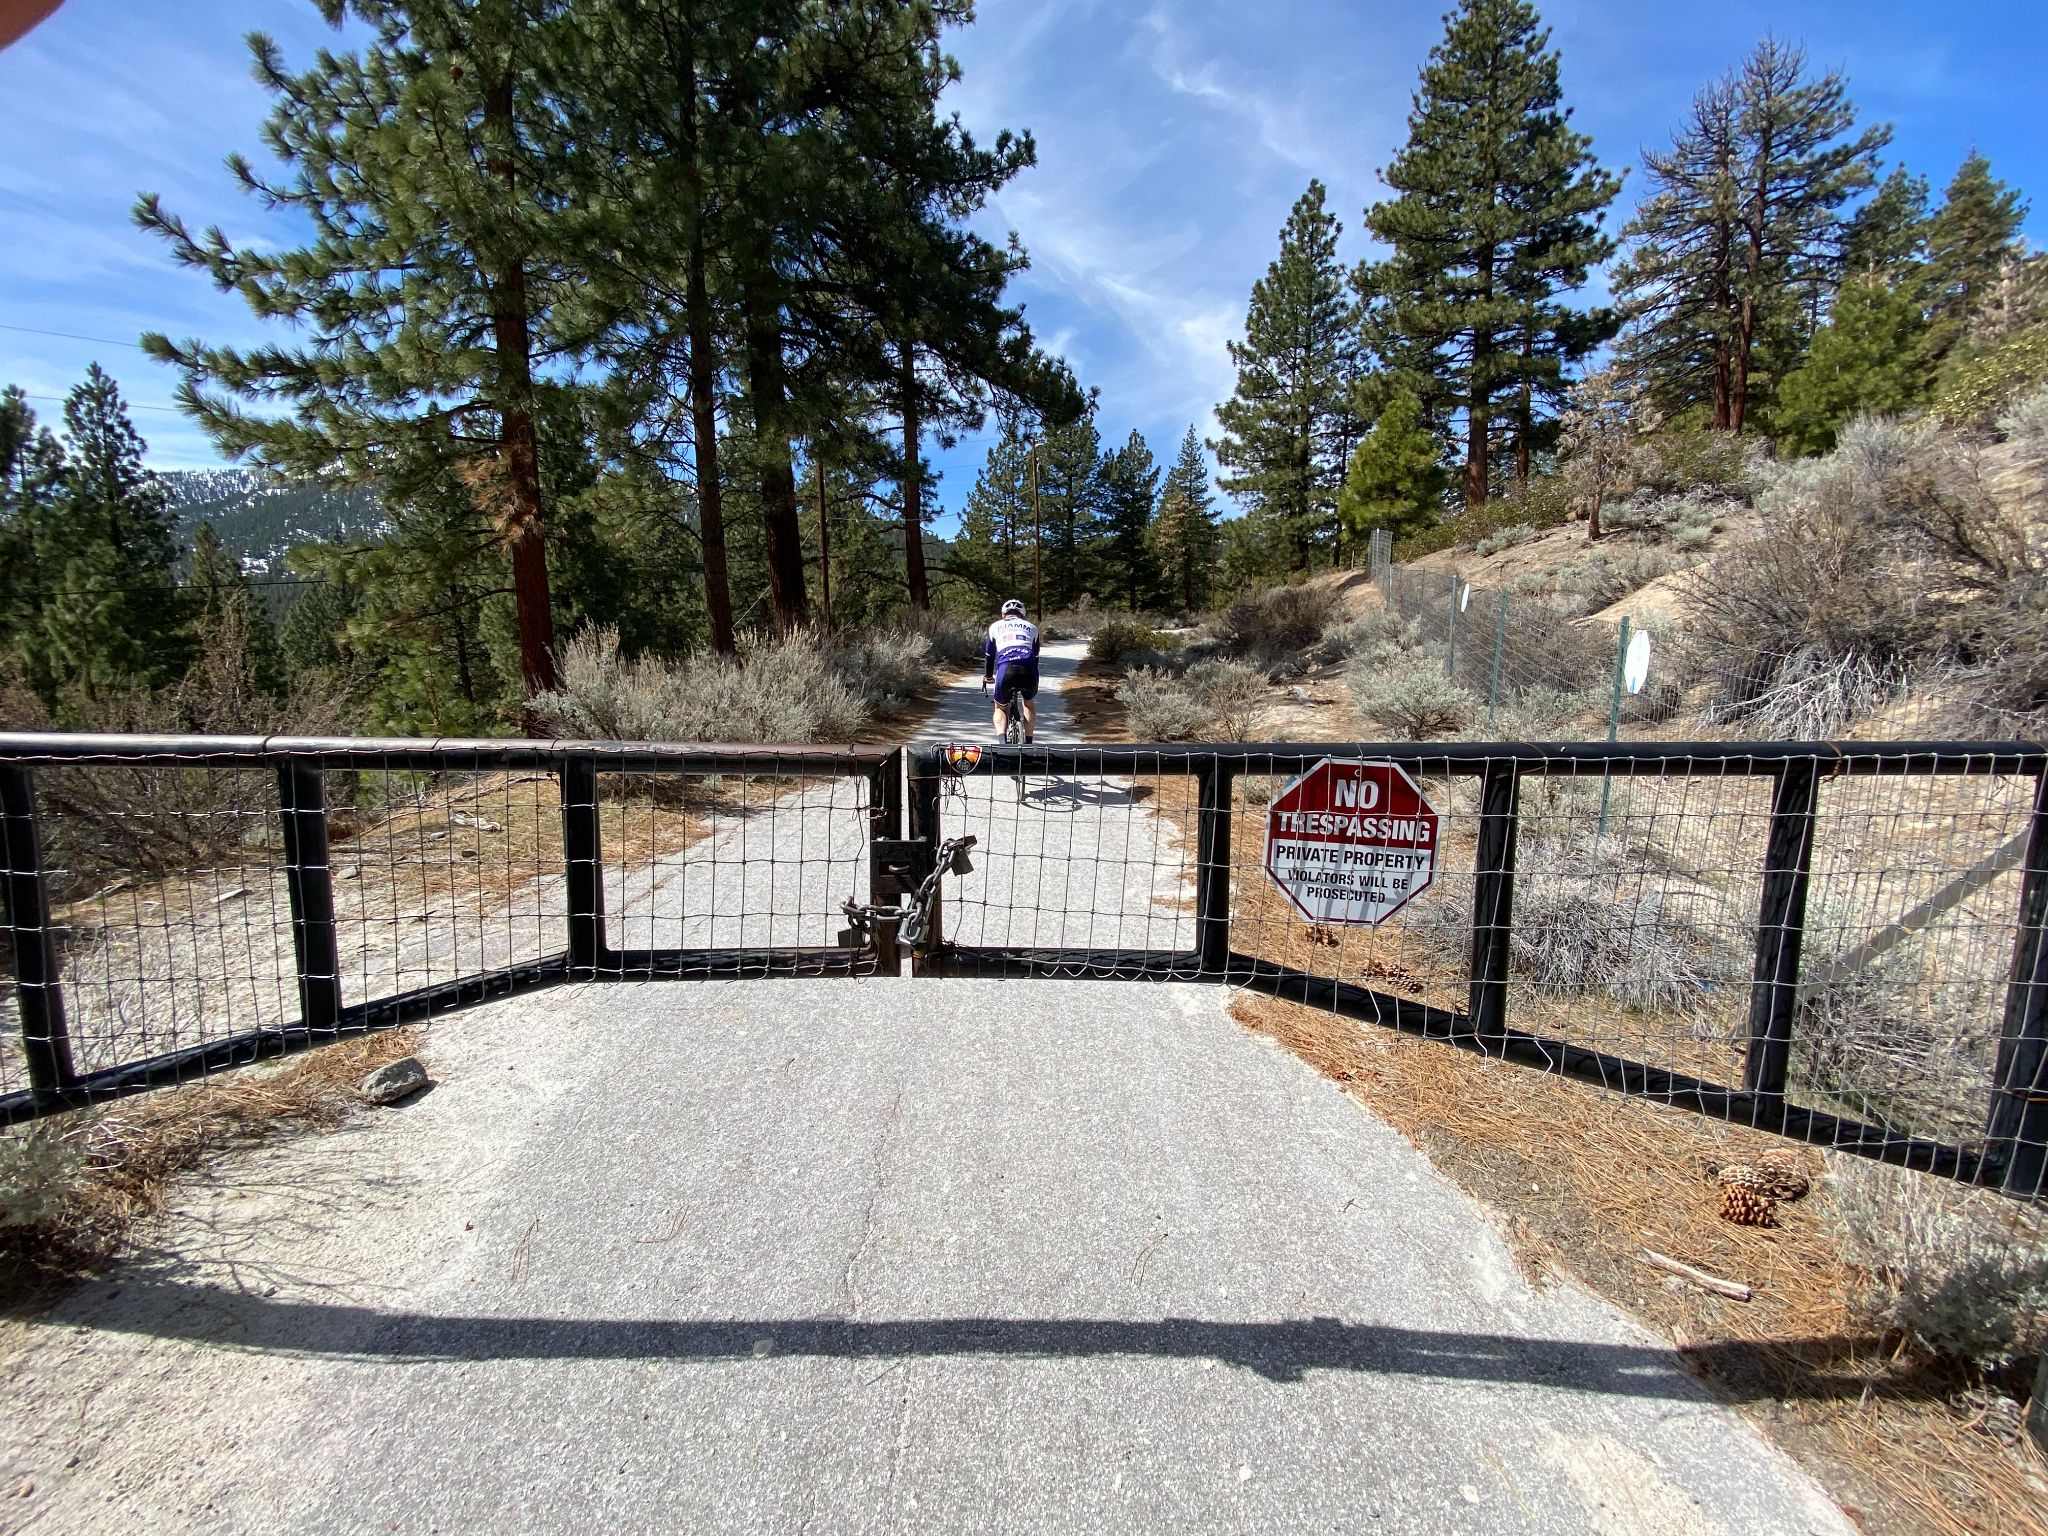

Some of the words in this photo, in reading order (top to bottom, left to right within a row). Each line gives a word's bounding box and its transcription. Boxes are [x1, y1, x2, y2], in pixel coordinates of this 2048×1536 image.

[1334, 779, 1379, 809] NO
[1277, 812, 1430, 842] TRESPASSING
[1275, 844, 1339, 864] PRIVATE
[1343, 851, 1425, 870] PROPERTY
[1288, 869, 1354, 886] VIOLATORS
[1359, 875, 1388, 889] WILL
[1392, 878, 1408, 890] BE
[1306, 886, 1386, 904] PROSECUTED
